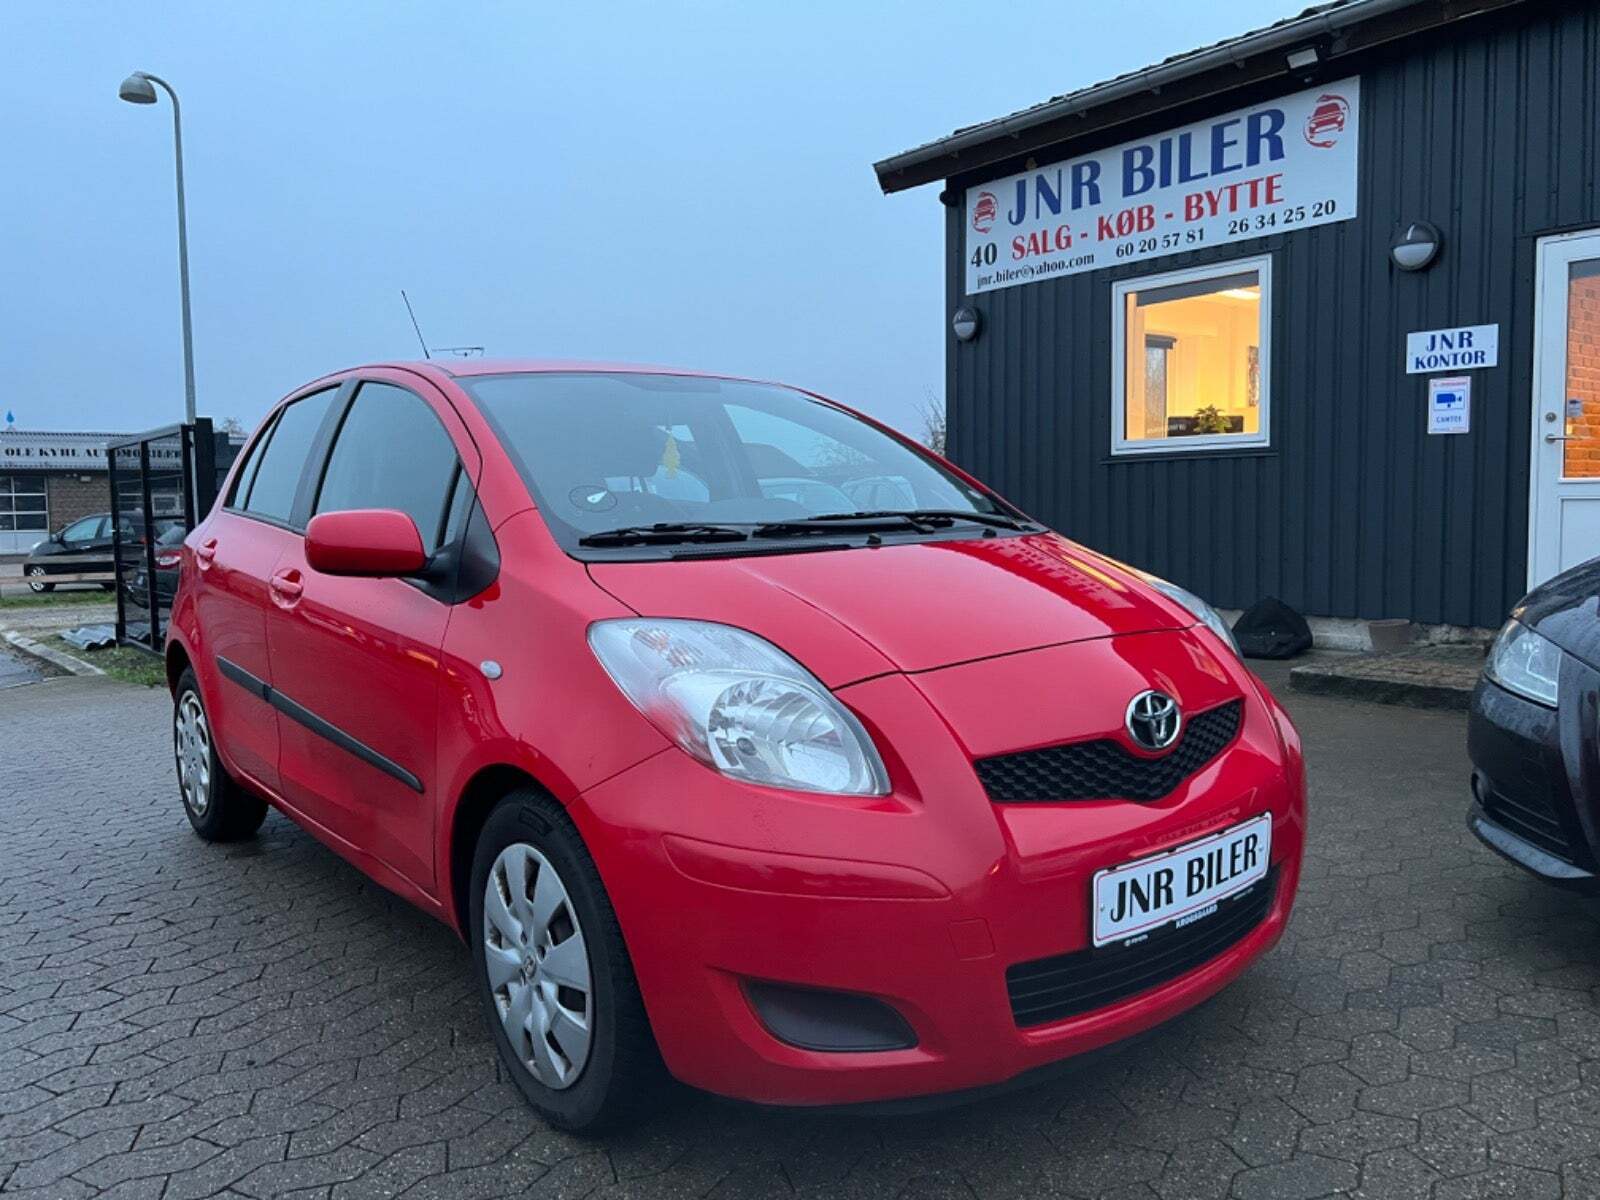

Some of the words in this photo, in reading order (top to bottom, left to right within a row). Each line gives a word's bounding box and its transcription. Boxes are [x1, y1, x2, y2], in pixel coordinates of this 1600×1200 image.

[1008, 159, 1101, 226] JNR
[1122, 108, 1285, 198] BILER
[1012, 224, 1072, 261] SALG
[1097, 203, 1155, 242] KØB
[1185, 174, 1285, 223] BYTTE
[1116, 243, 1134, 258] 60
[1138, 238, 1157, 253] 20
[1162, 232, 1181, 248] 57
[1185, 227, 1204, 243] 81
[1228, 219, 1249, 235] 26
[1255, 211, 1276, 229] 34
[1283, 205, 1306, 224] 25
[1312, 199, 1336, 218] 20
[971, 242, 998, 268] 40
[977, 253, 1095, 289] jnr.biler@yahoo.com
[1426, 331, 1473, 352] JNR
[1415, 350, 1486, 370] KONTOR
[5, 447, 34, 457] OLE
[39, 447, 79, 457] KYHL
[1110, 868, 1174, 923] JNR
[1186, 833, 1258, 898] BILER
